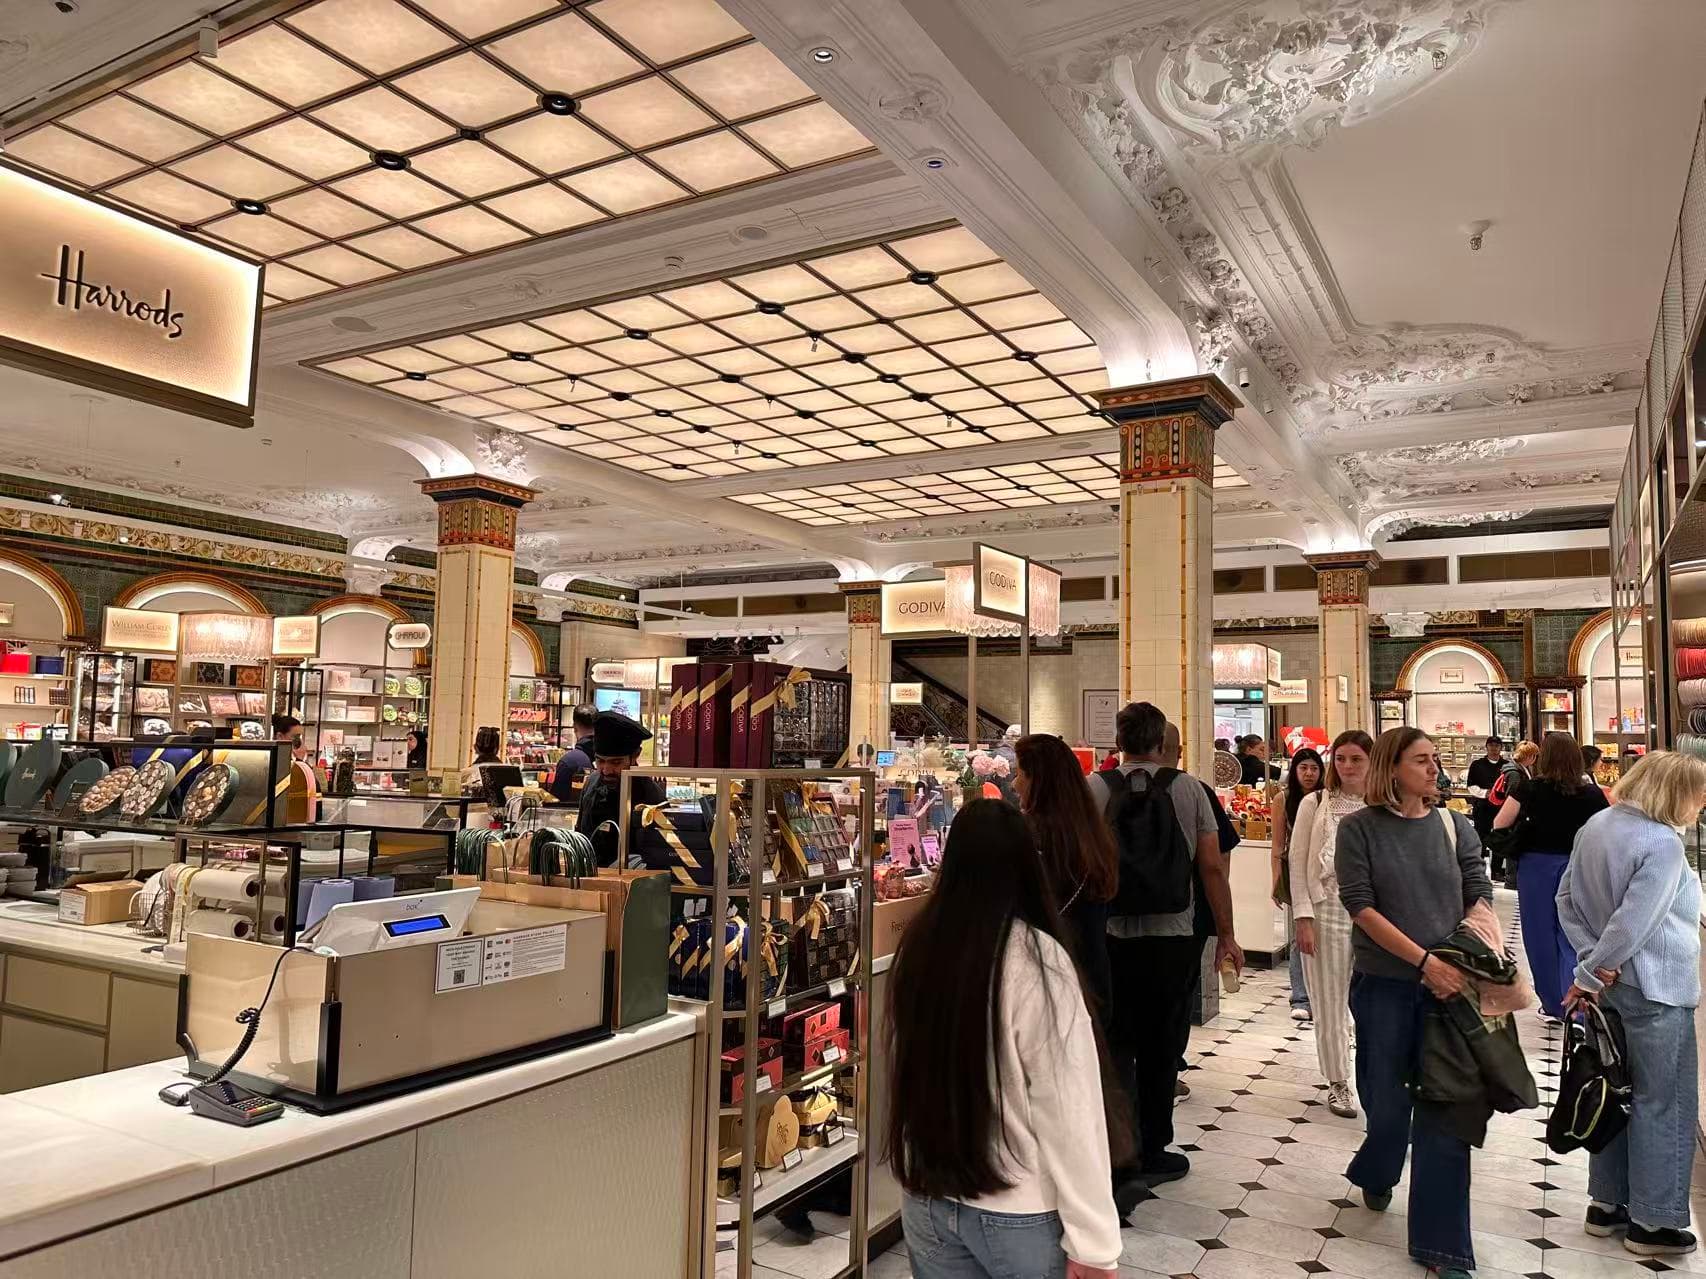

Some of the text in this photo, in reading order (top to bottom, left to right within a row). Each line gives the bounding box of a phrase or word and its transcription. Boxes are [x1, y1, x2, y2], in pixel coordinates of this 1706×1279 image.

[41, 244, 184, 339] Harrods
[989, 571, 1016, 591] GODIVA
[111, 619, 145, 630] WILLIAM
